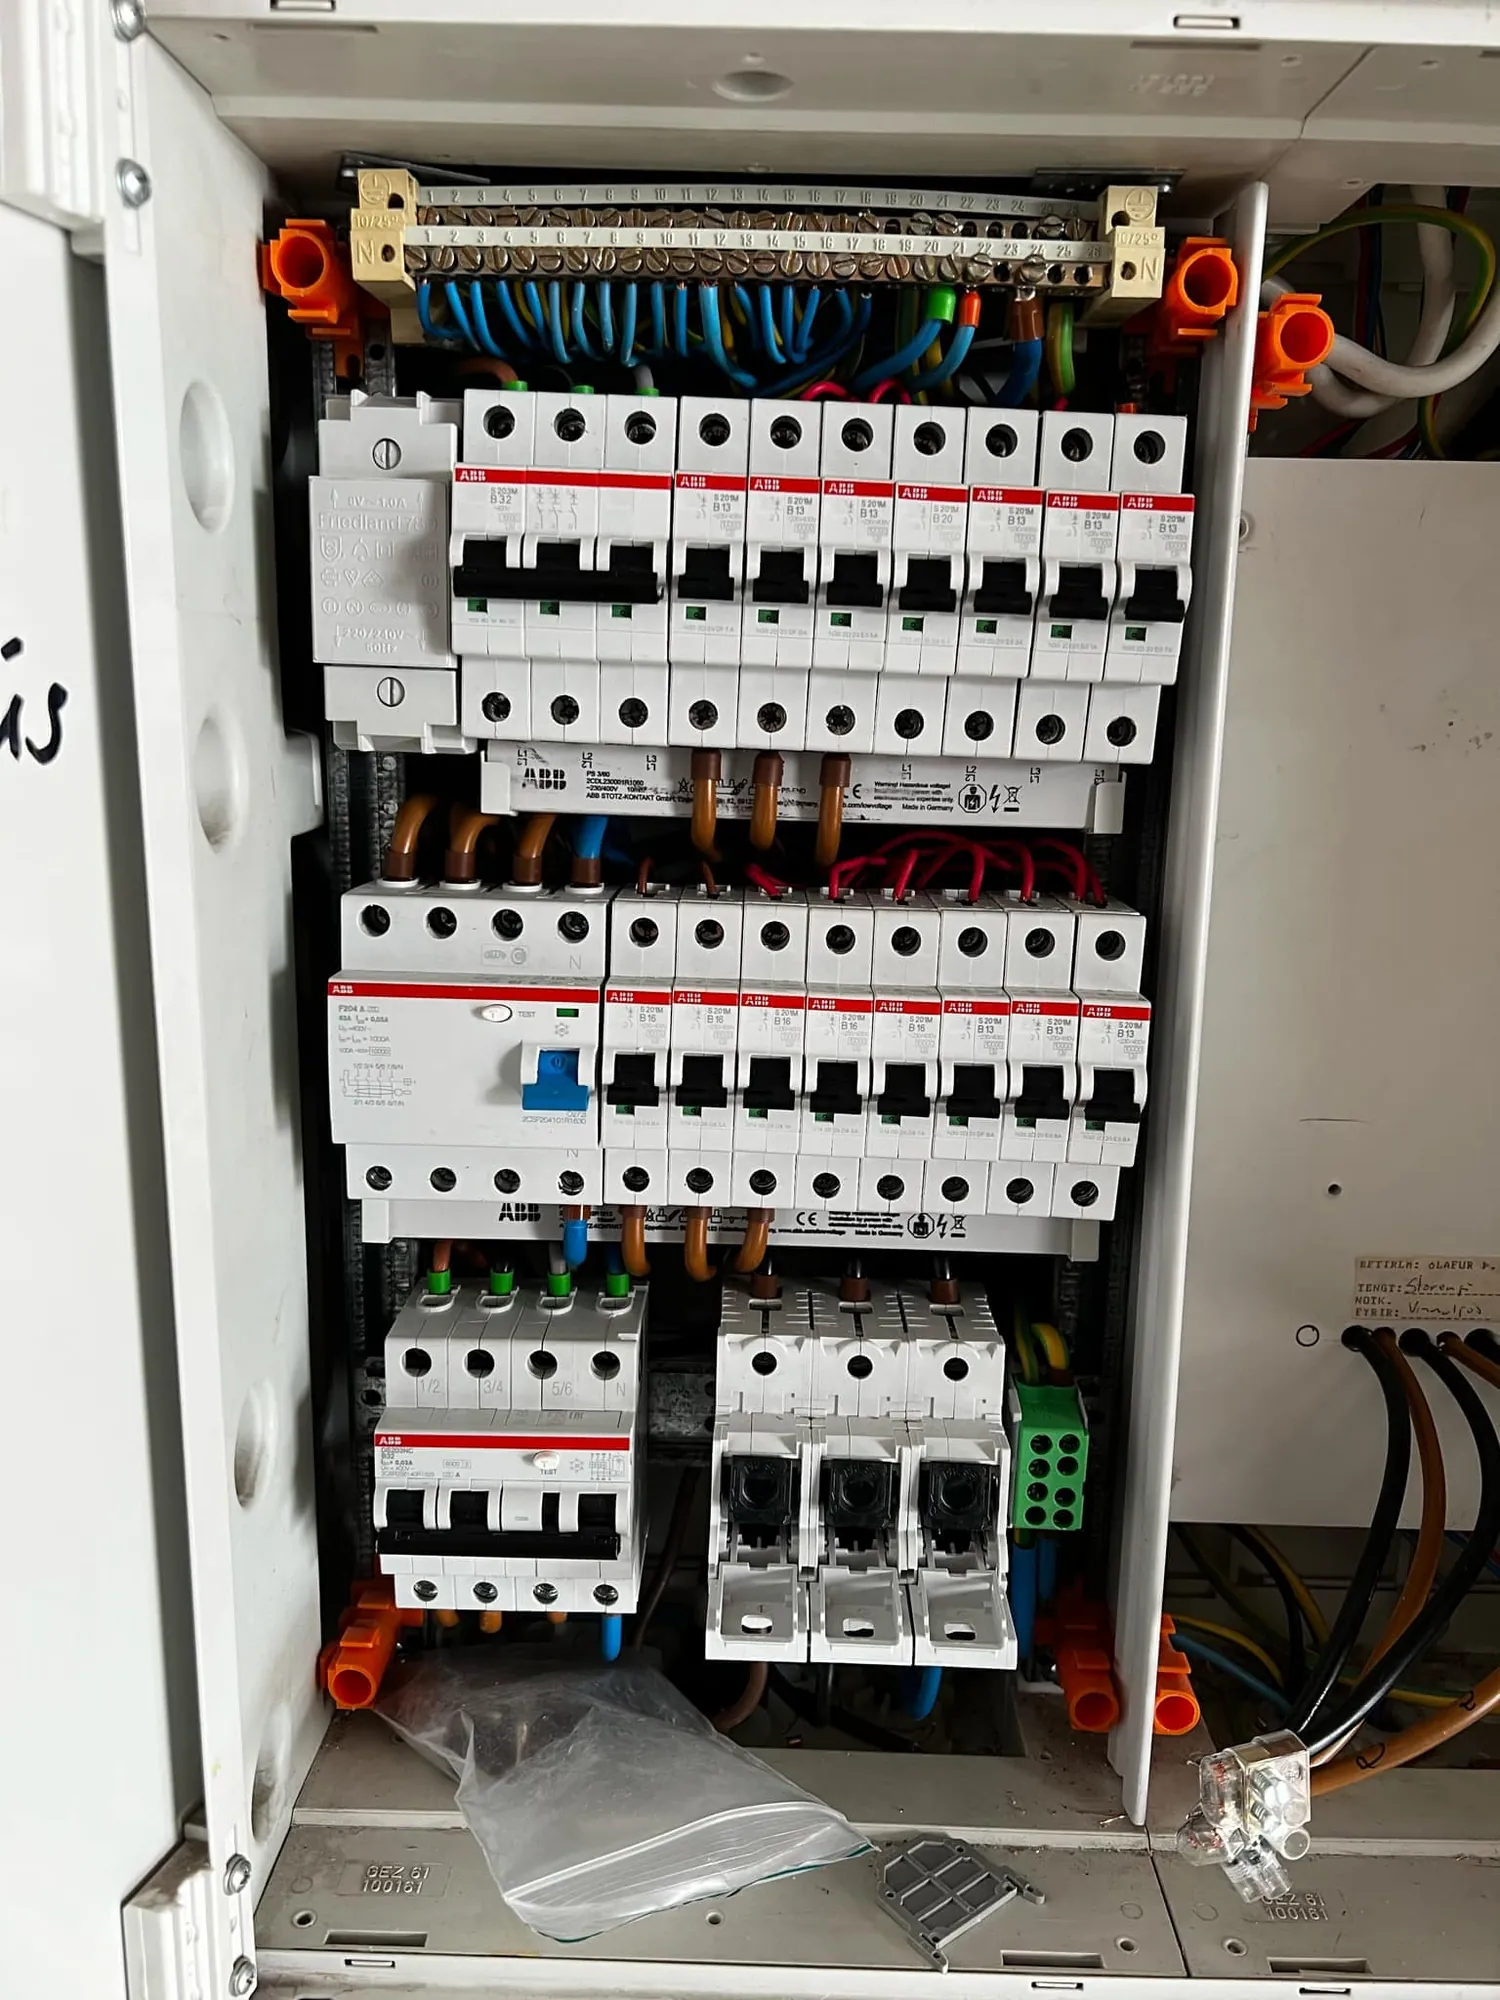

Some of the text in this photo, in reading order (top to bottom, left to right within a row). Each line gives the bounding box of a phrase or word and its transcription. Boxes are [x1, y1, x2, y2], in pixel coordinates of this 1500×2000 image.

[429, 190, 434, 201] 1
[452, 190, 460, 202] 2
[477, 190, 486, 202] 3
[503, 190, 513, 202] 4
[528, 190, 537, 201] 5
[555, 190, 563, 201] 6
[580, 189, 588, 200] 7
[606, 189, 614, 200] 8
[631, 188, 639, 199] 9
[655, 189, 667, 200] 10
[682, 189, 692, 200] 11
[707, 189, 718, 200] 12
[732, 188, 743, 200] 13
[758, 188, 769, 200] 14
[784, 189, 795, 201] 15
[809, 190, 820, 202] 16
[835, 190, 846, 203] 17
[861, 191, 872, 203] 18
[886, 192, 897, 204] 19
[909, 194, 924, 205] 20
[936, 195, 949, 207] 21
[961, 197, 974, 208] 22
[425, 231, 431, 242] 1
[450, 231, 459, 242] 2
[477, 232, 484, 242] 3
[504, 232, 512, 242] 4
[530, 232, 539, 243] 5
[558, 232, 566, 243] 6
[584, 232, 592, 243] 7
[610, 232, 619, 243] 8
[637, 232, 645, 244] 9
[661, 233, 673, 244] 10
[689, 233, 699, 245] 11
[714, 234, 726, 245] 12
[741, 234, 752, 246] 13
[768, 235, 778, 247] 14
[794, 236, 805, 248] 15
[821, 237, 832, 248] 16
[848, 238, 859, 249] 17
[874, 238, 886, 250] 18
[900, 240, 912, 251] 19
[925, 240, 939, 253] 20
[356, 240, 374, 264] N
[1141, 258, 1156, 280] N
[460, 470, 486, 481] ABB
[681, 476, 706, 487] ABB
[754, 479, 780, 490] ABB
[828, 483, 854, 494] ABB
[902, 487, 927, 499] ABB
[977, 489, 1002, 501] ABB
[1052, 496, 1078, 507] ABB
[1127, 497, 1153, 509] ABB
[582, 752, 593, 760] L2
[569, 955, 582, 970] N
[332, 985, 353, 994] ABB
[610, 992, 634, 1002] ABB
[677, 993, 702, 1003] ABB
[745, 996, 769, 1006] ABB
[812, 999, 836, 1010] ABB
[880, 1002, 903, 1012] ABB
[948, 1003, 972, 1013] ABB
[1016, 1003, 1040, 1014] ABB
[1087, 1007, 1111, 1017] ABB
[499, 1203, 541, 1221] ABB
[1358, 1284, 1402, 1292] TENGT:
[420, 1381, 440, 1394] 1/2
[484, 1381, 503, 1393] 3/4
[552, 1382, 572, 1395] 5/6
[616, 1383, 626, 1396] N
[379, 1437, 402, 1445] ABB
[367, 1866, 430, 1879] GEZ 61
[363, 1880, 423, 1894] 100161
[1266, 1907, 1329, 1920] 100161
